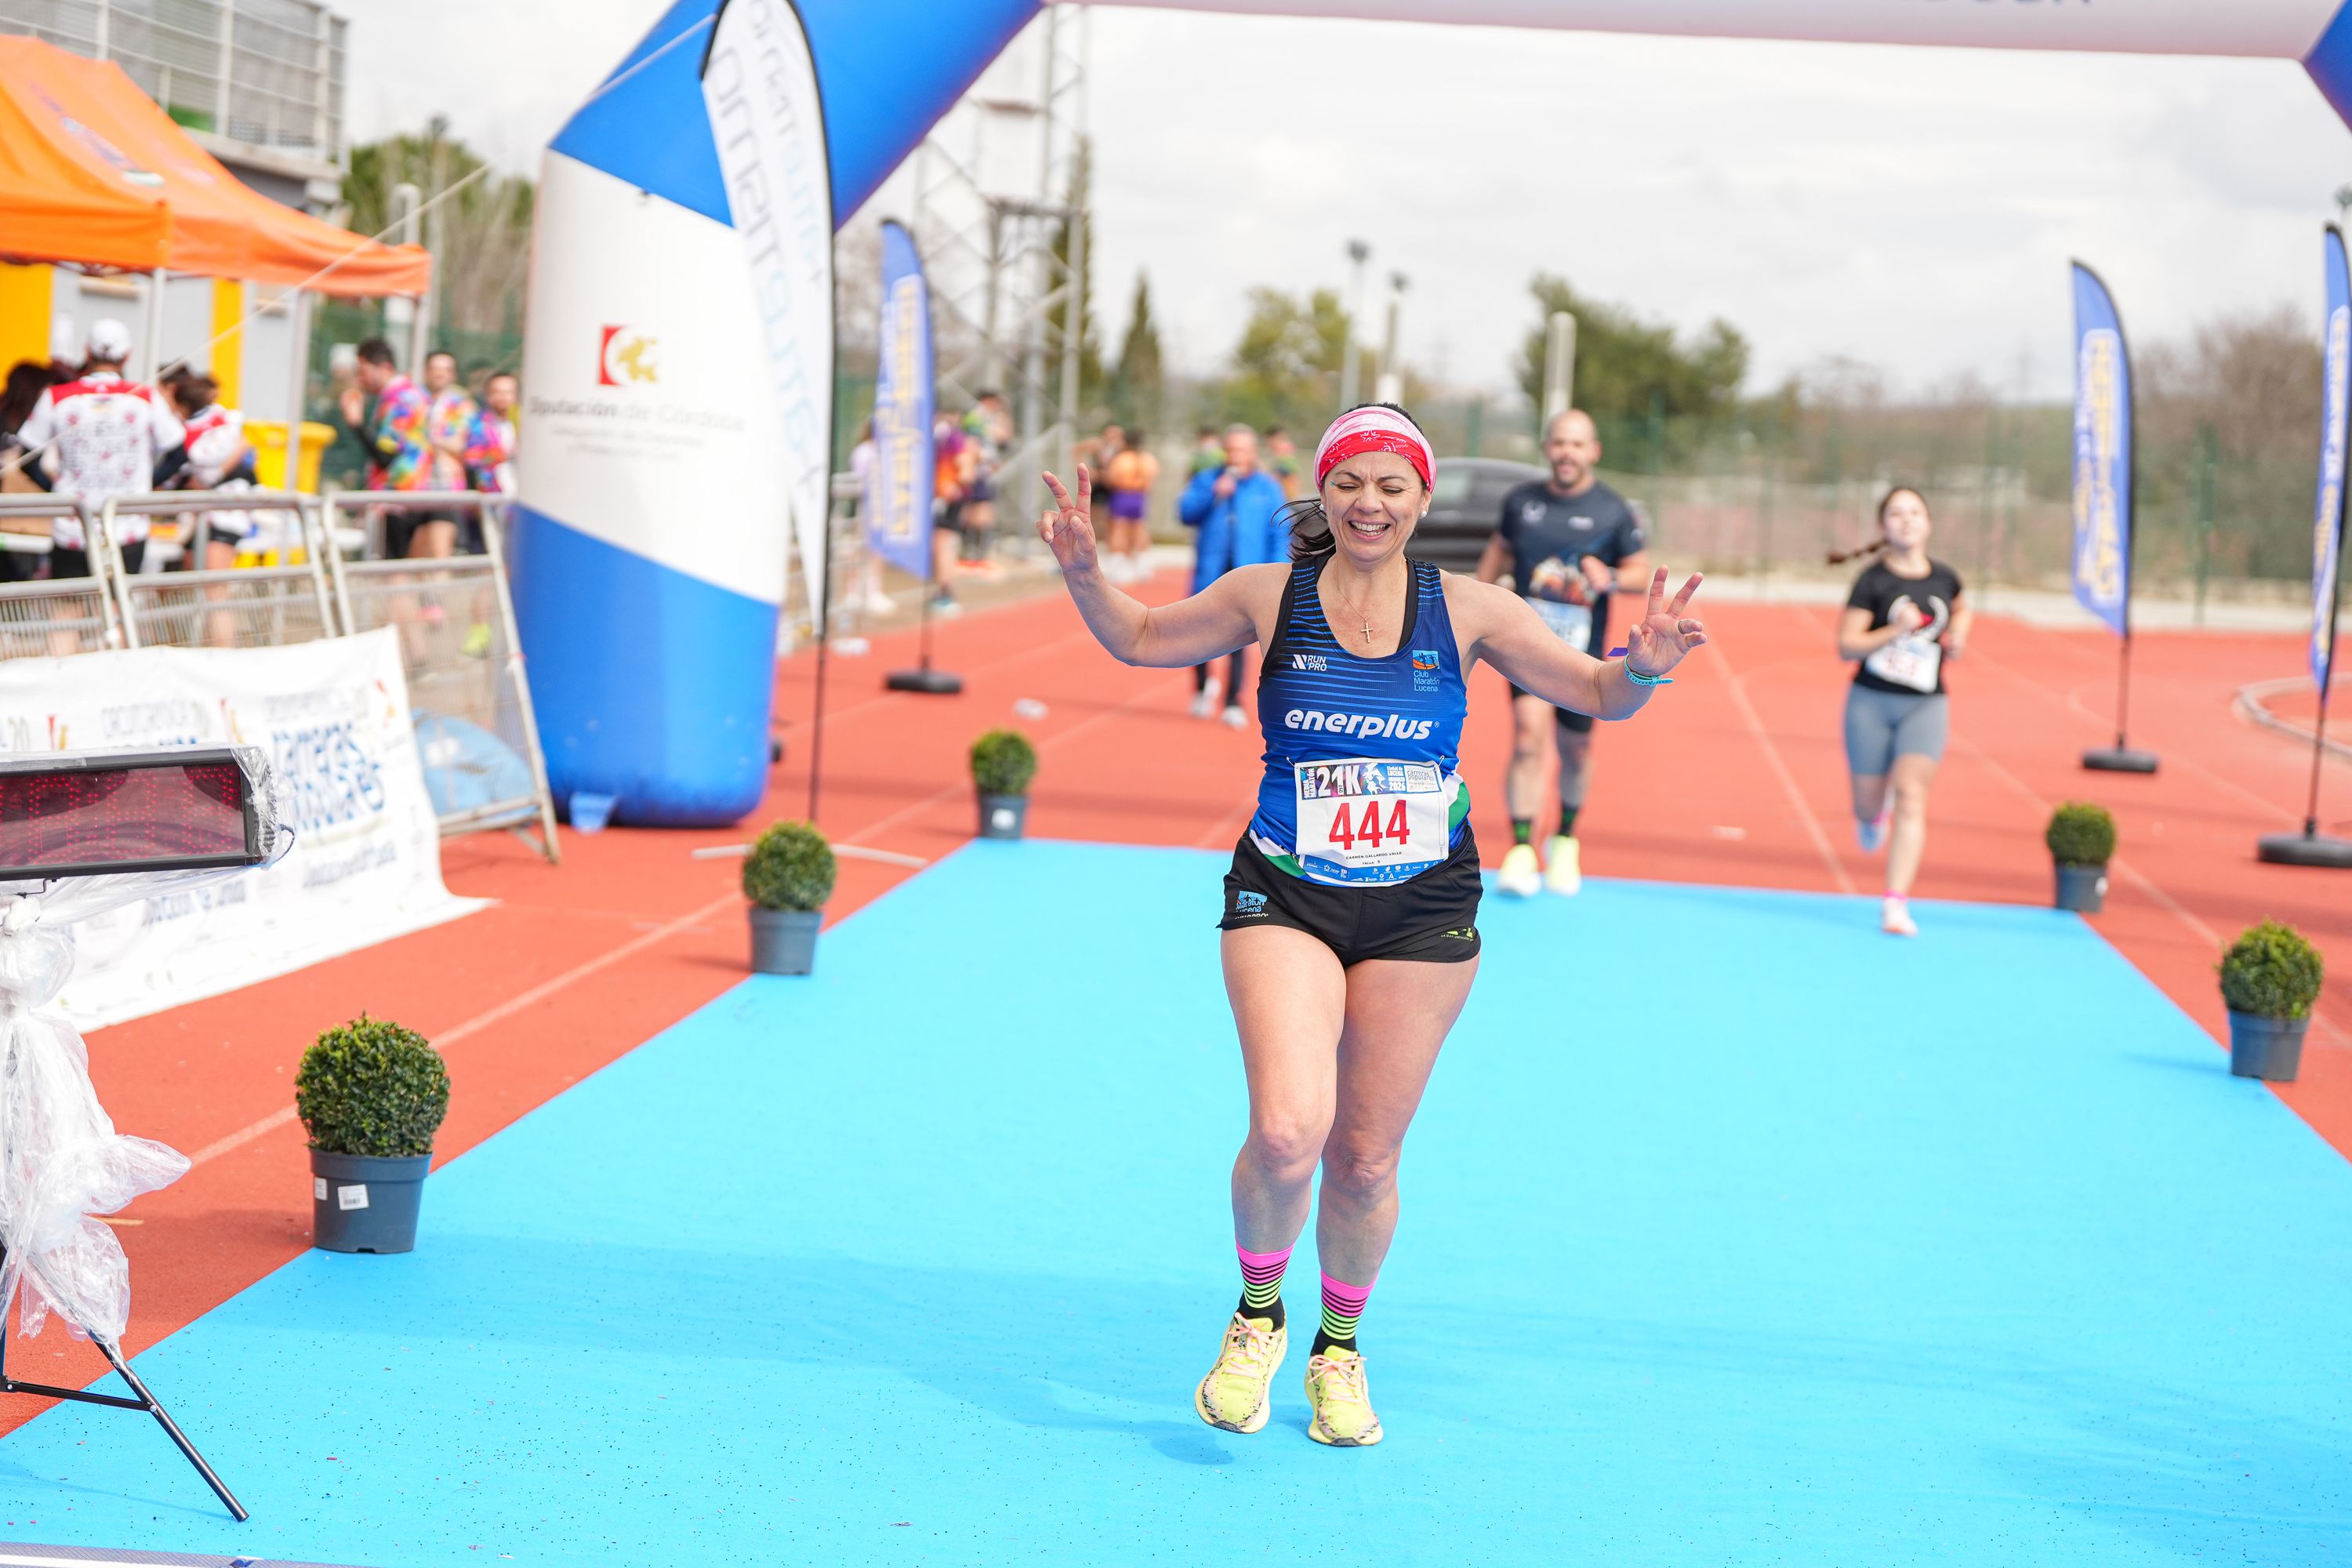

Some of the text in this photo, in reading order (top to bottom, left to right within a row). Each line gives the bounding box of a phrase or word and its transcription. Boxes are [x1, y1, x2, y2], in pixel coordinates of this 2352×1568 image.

[1307, 655, 1327, 663] RUN
[1308, 662, 1327, 672] PRO
[1316, 764, 1363, 797] 21K
[1388, 782, 1406, 791] 2026
[1329, 799, 1410, 851] 444
